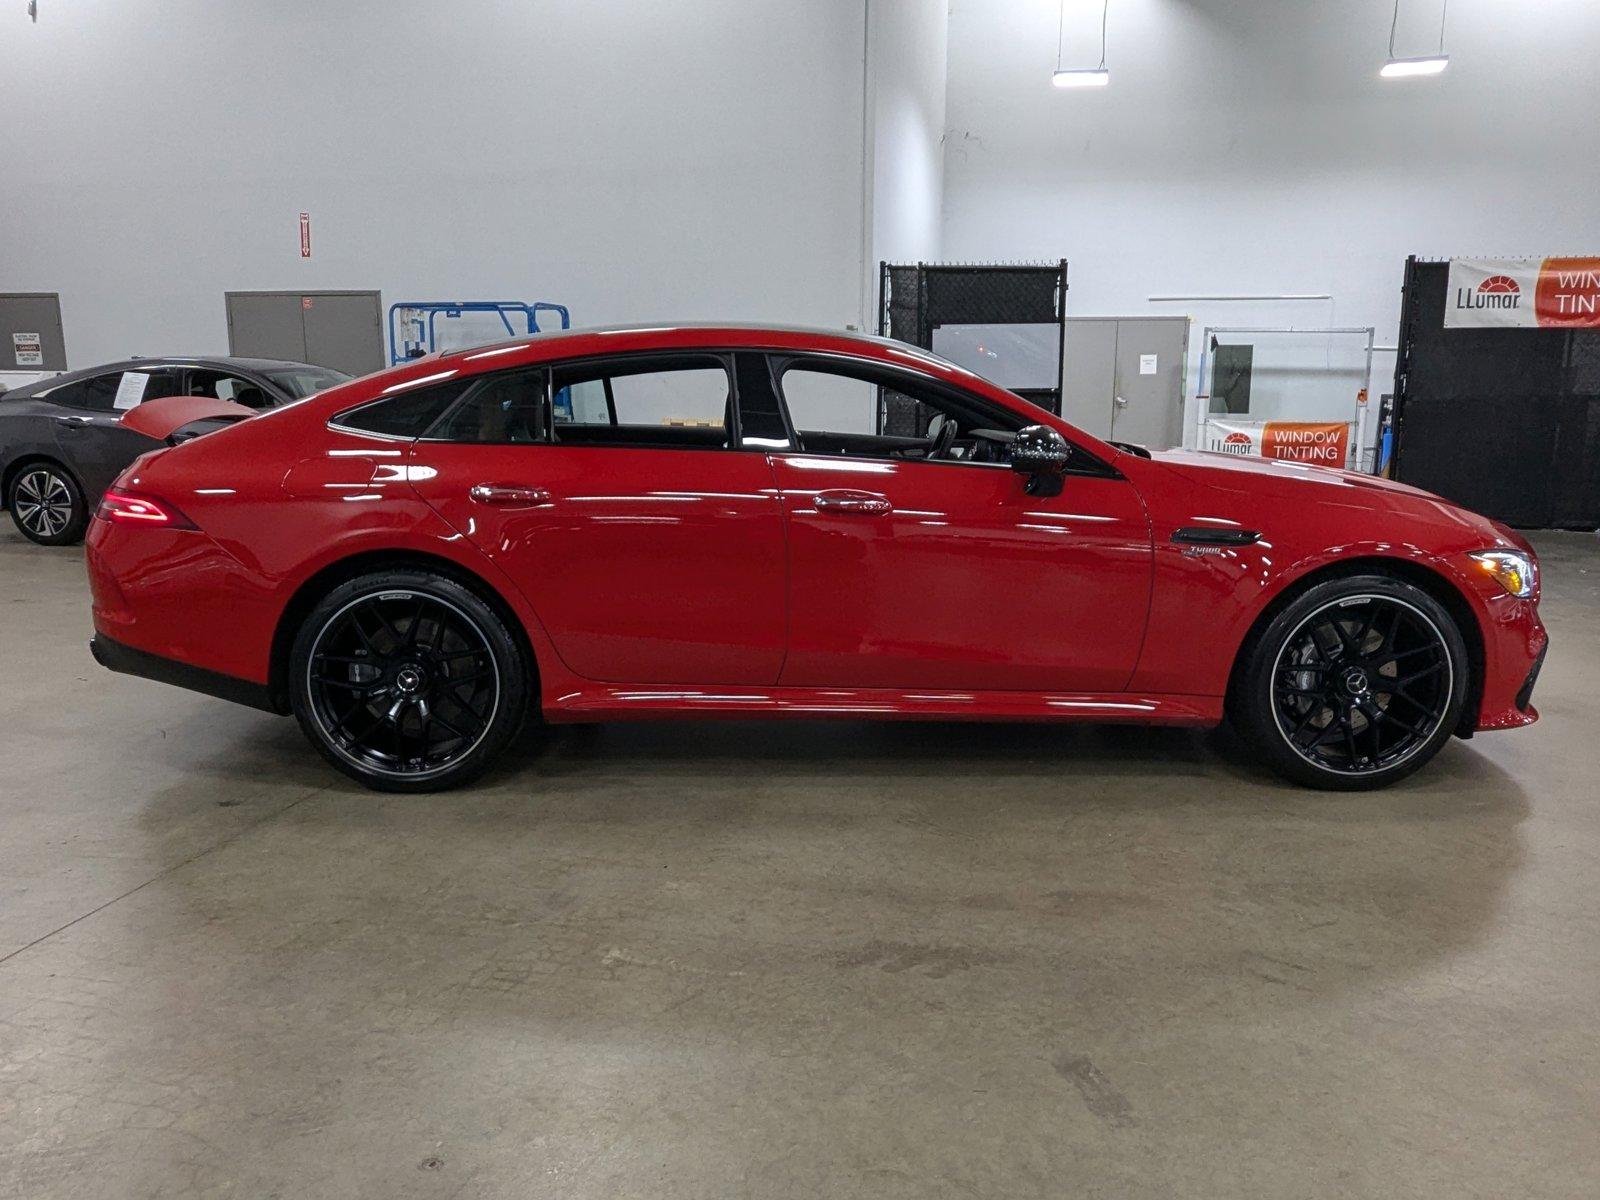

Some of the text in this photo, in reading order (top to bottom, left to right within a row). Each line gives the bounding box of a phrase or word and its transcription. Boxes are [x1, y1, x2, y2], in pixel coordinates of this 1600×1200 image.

[1456, 287, 1520, 310] LLumar
[1554, 294, 1600, 313] TIN
[1274, 430, 1340, 444] WINDOW
[1273, 445, 1338, 460] TINTING
